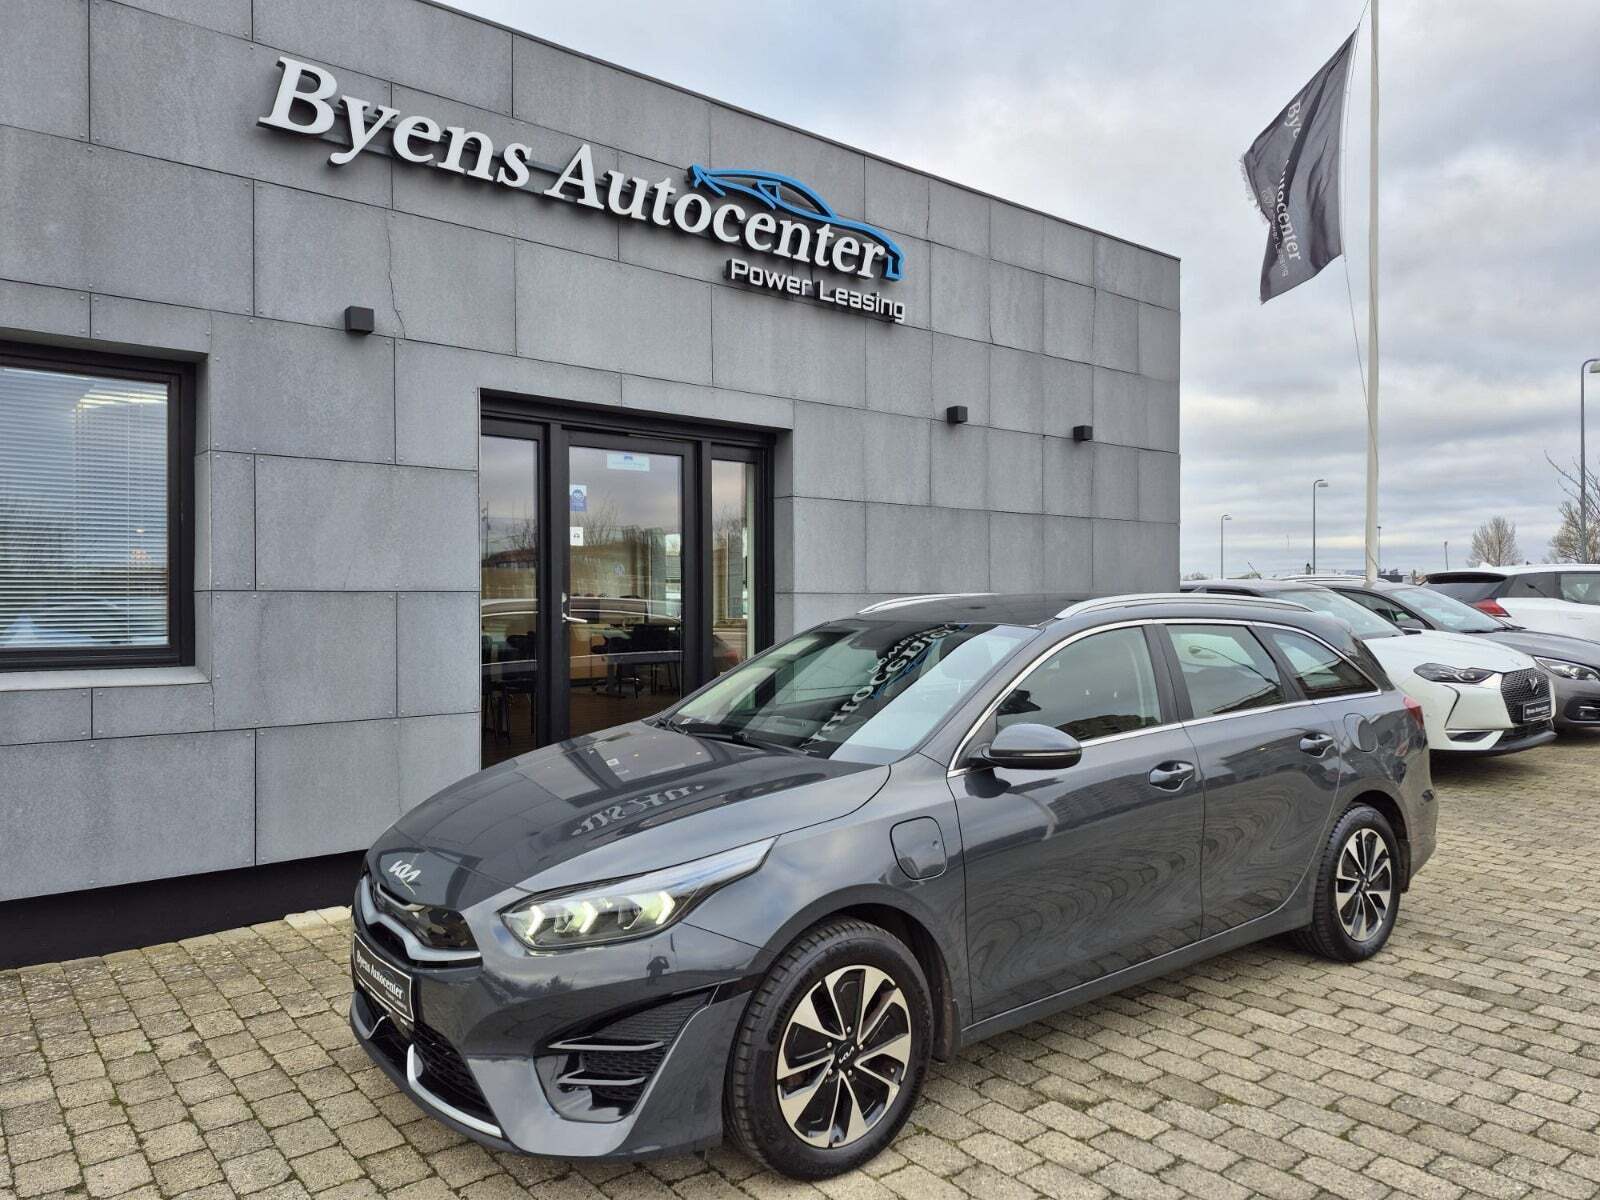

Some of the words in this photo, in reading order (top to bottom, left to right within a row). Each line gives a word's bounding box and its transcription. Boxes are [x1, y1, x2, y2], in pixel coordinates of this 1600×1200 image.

[257, 56, 532, 188] Byens
[543, 143, 886, 279] Autocenter
[1276, 160, 1302, 261] tocenter
[730, 257, 812, 296] Power
[819, 279, 906, 324] Leasing
